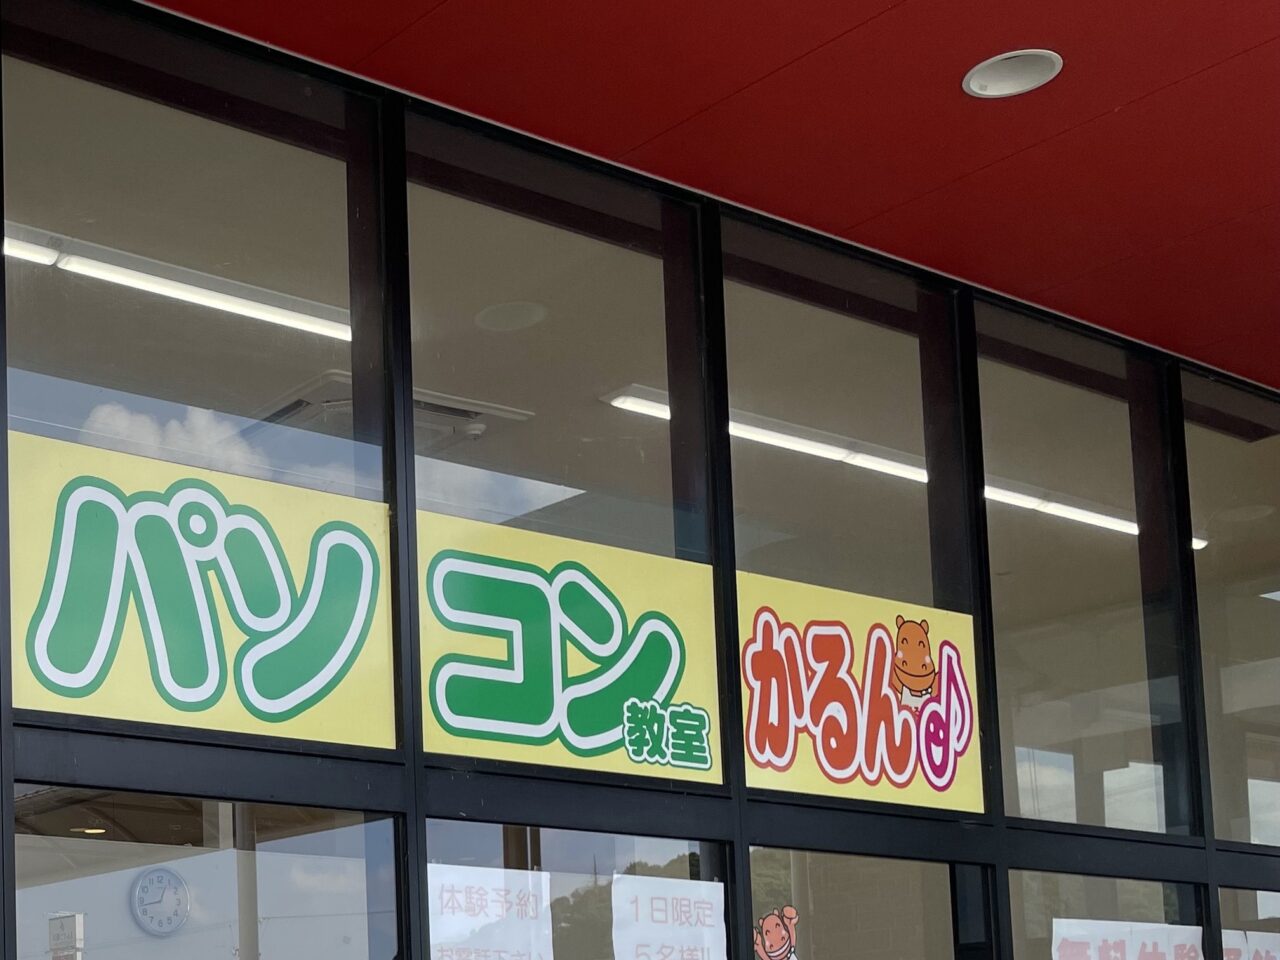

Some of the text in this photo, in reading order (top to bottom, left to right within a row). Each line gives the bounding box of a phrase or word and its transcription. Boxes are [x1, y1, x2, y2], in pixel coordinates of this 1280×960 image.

[624, 697, 712, 771] 教室
[438, 884, 539, 921] 体験予約
[630, 896, 714, 928] 1日限定
